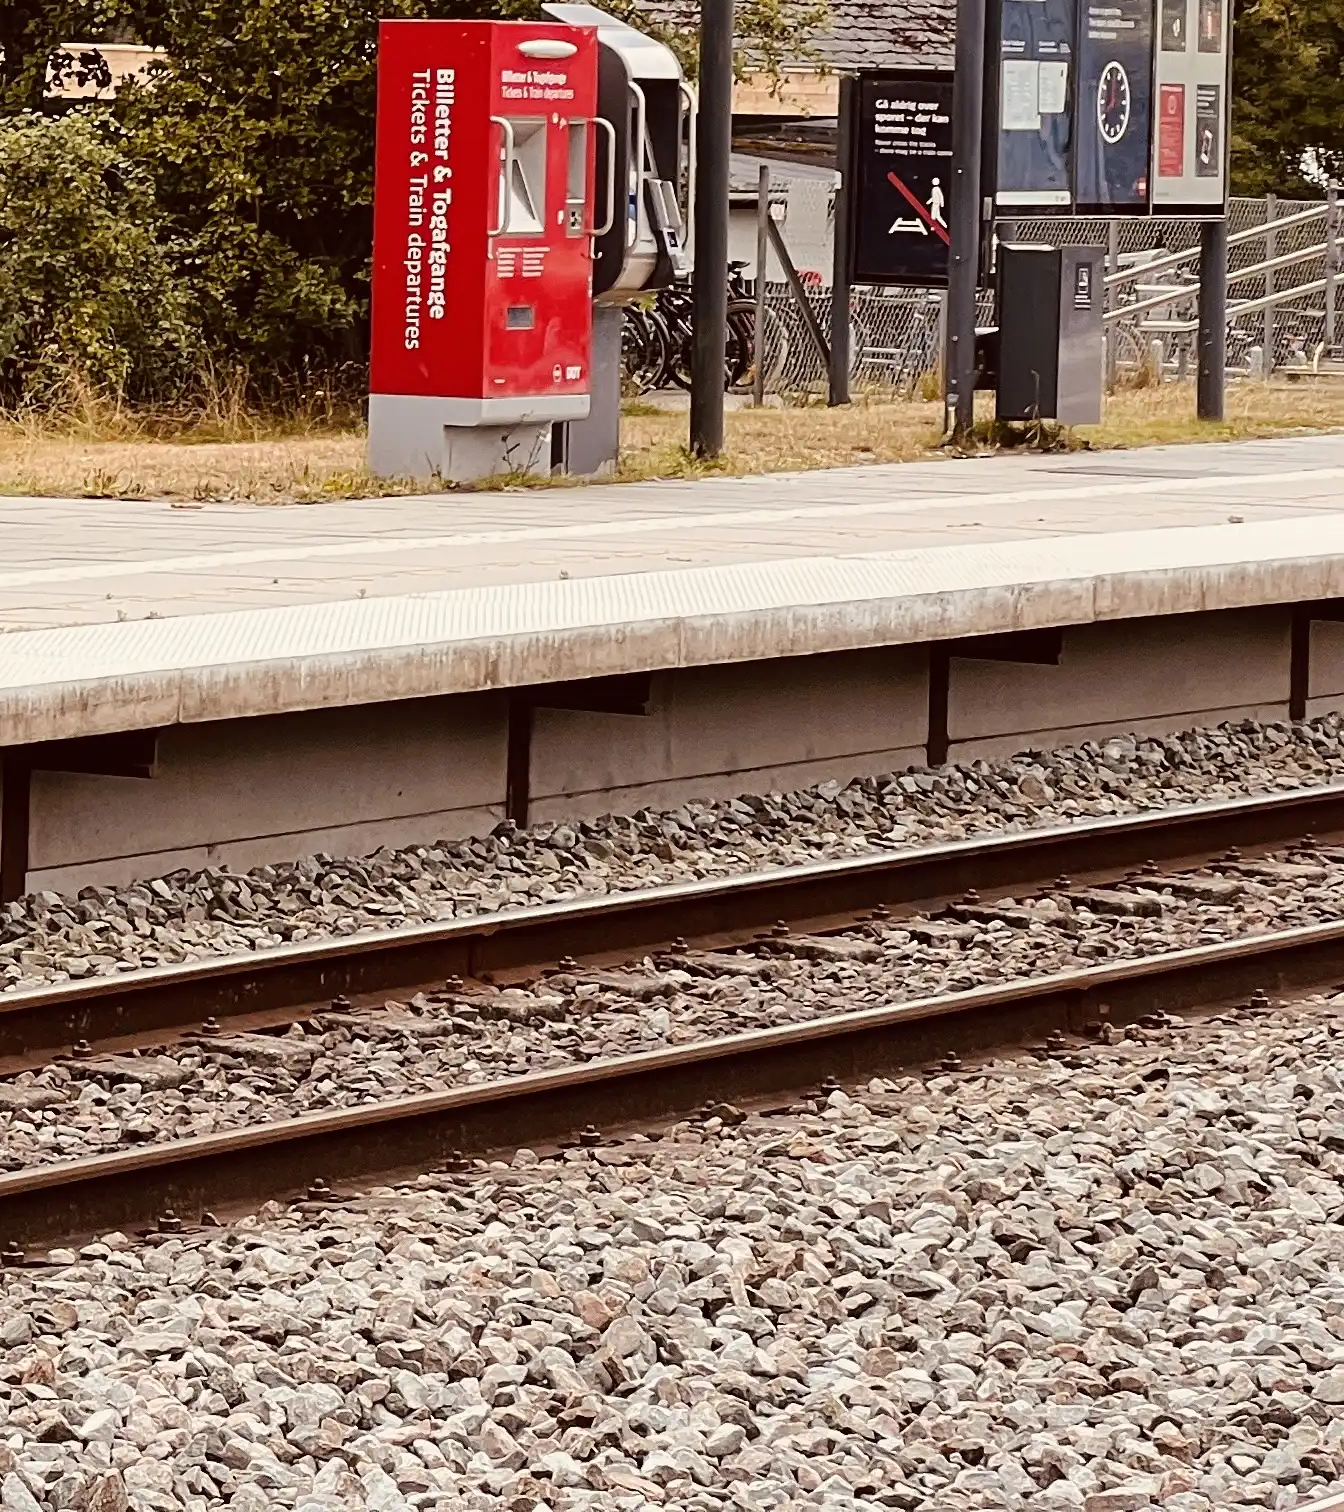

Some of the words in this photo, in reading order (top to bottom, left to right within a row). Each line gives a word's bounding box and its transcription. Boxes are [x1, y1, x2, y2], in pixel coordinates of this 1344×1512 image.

[411, 68, 430, 144] Tickets
[434, 69, 454, 160] Billetter
[410, 151, 428, 167] &
[433, 165, 452, 183] &
[408, 174, 428, 226] Train
[403, 233, 427, 349] departures
[427, 188, 452, 319] Togafgange
